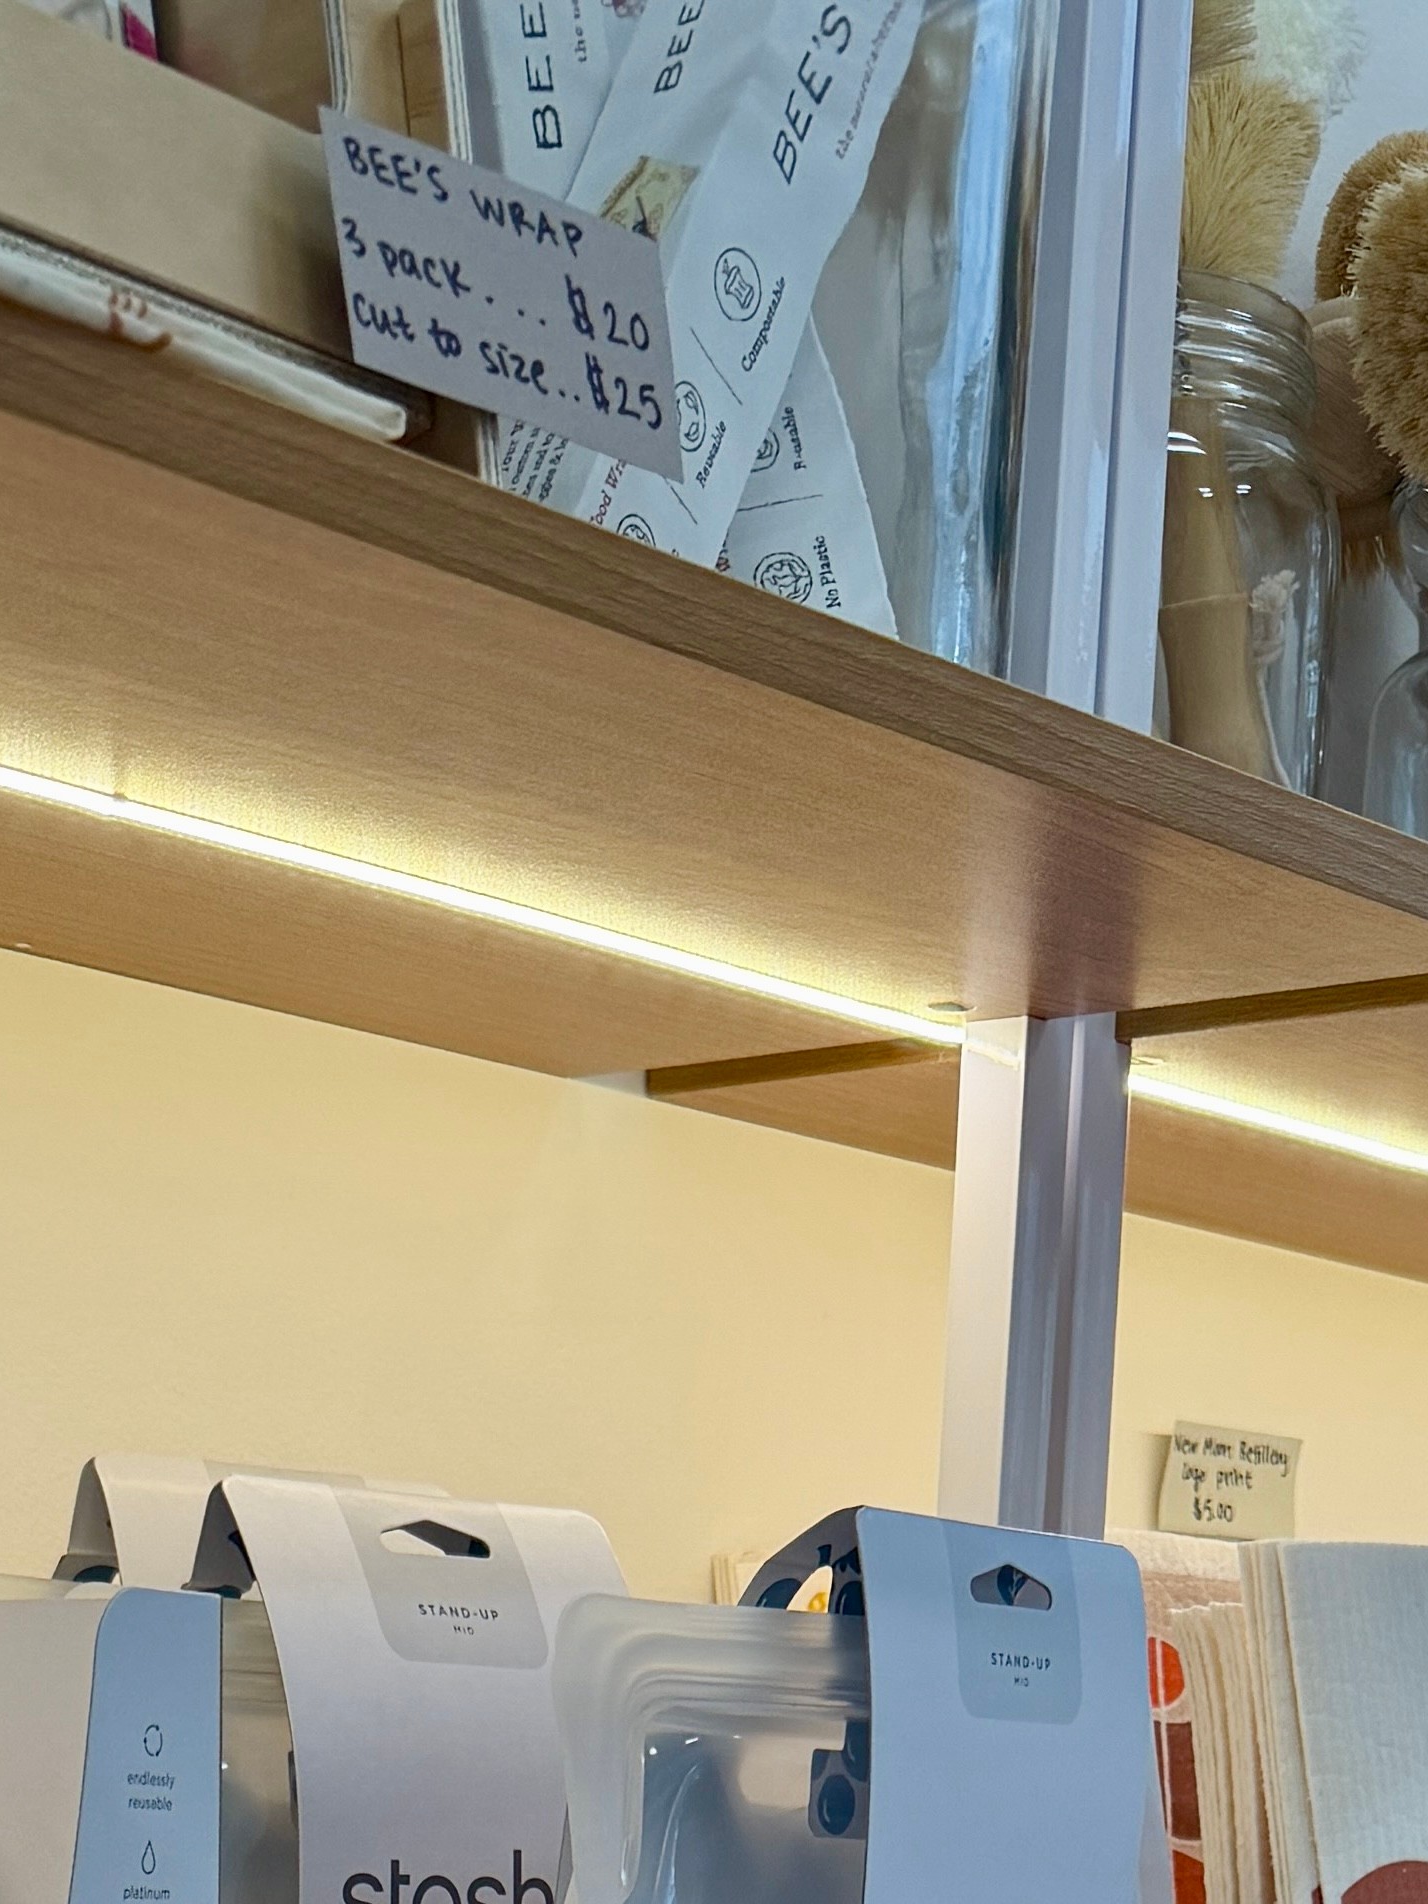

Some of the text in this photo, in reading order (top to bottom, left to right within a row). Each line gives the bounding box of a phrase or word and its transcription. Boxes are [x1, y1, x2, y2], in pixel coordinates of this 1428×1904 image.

[772, 3, 855, 186] BEE'S
[343, 136, 584, 259] BEE'S WRAP
[340, 216, 368, 259] 3
[564, 273, 650, 353] $20
[740, 275, 787, 373] Compostable
[584, 351, 664, 431] $25
[812, 534, 843, 611] No Plastic
[1192, 1496, 1235, 1524] $5.00
[417, 1603, 500, 1623] STAND-UP
[123, 1884, 171, 1904] platinum
